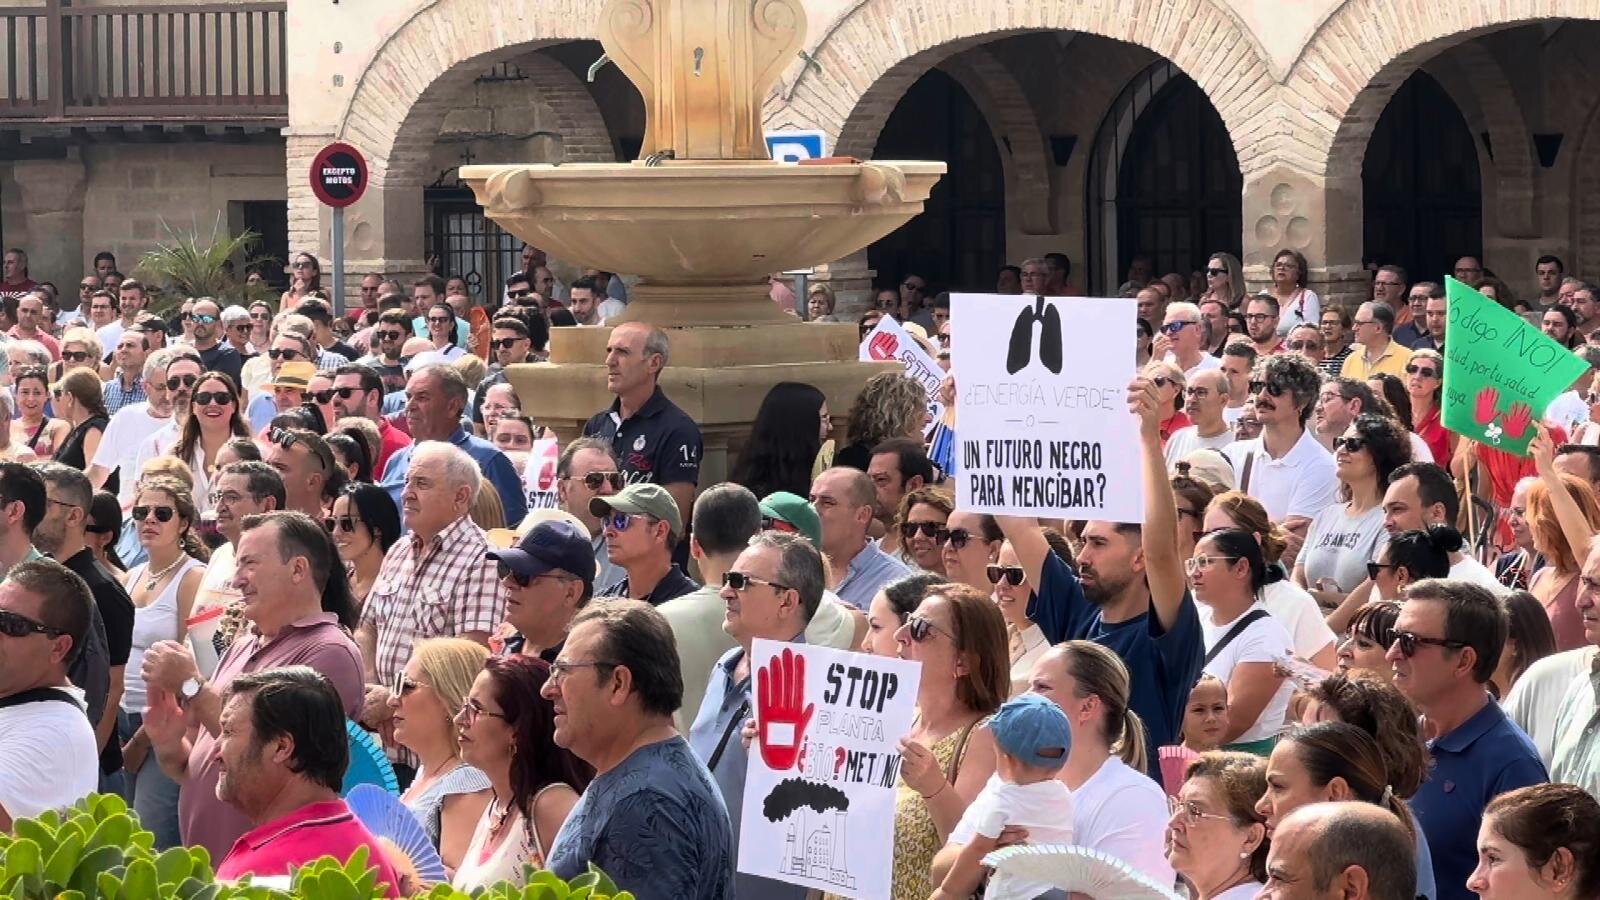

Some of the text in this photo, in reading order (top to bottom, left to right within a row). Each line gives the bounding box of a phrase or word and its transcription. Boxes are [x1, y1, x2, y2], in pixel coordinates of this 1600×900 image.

[322, 167, 356, 175] EXCEPTO
[325, 176, 353, 184] MOTOS
[1461, 307, 1498, 344] digo
[1504, 376, 1541, 399] salud
[963, 439, 1102, 470] UN FUTURO NEGRO
[970, 474, 1006, 506] PARA
[823, 662, 899, 713] STOP
[815, 709, 885, 742] PLANTA
